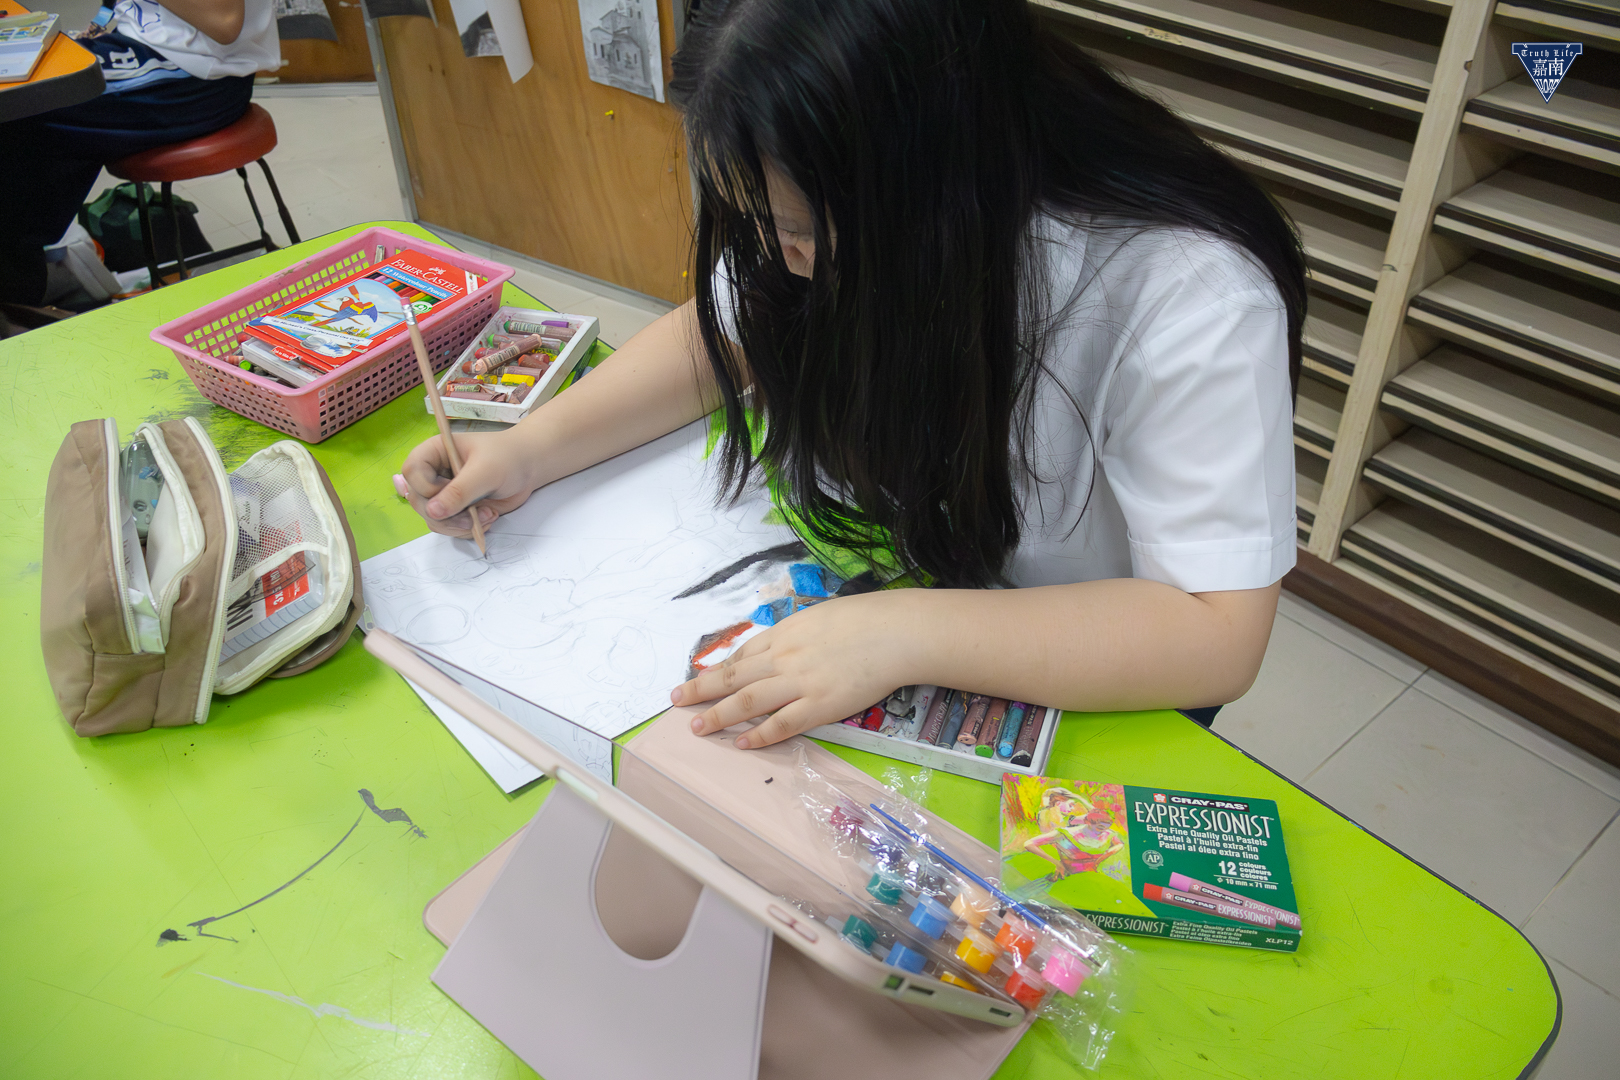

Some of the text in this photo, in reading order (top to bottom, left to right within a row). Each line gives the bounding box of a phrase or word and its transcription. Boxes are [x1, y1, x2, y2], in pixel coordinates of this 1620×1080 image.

[382, 267, 393, 275] 12
[391, 259, 464, 294] FABER-CASTELL
[1170, 796, 1247, 811] CRAY-PAS
[1134, 801, 1271, 839] EXPRESSIONIST
[1146, 824, 1268, 847] Extra Fine Quality Oil Pastels
[1157, 832, 1259, 853] Pastel à l'huile extra-fin
[1147, 854, 1160, 863] AP
[1158, 840, 1260, 861] Pastel al óleo extra fino
[1218, 860, 1267, 876] 12 colours
[1239, 867, 1272, 877] couleurs
[1240, 873, 1269, 881] colores
[1201, 887, 1242, 905] CRAY-PAS
[1174, 896, 1272, 926] CRAY-PAS EXPRESSIONIST
[1265, 937, 1294, 946] XLP12
